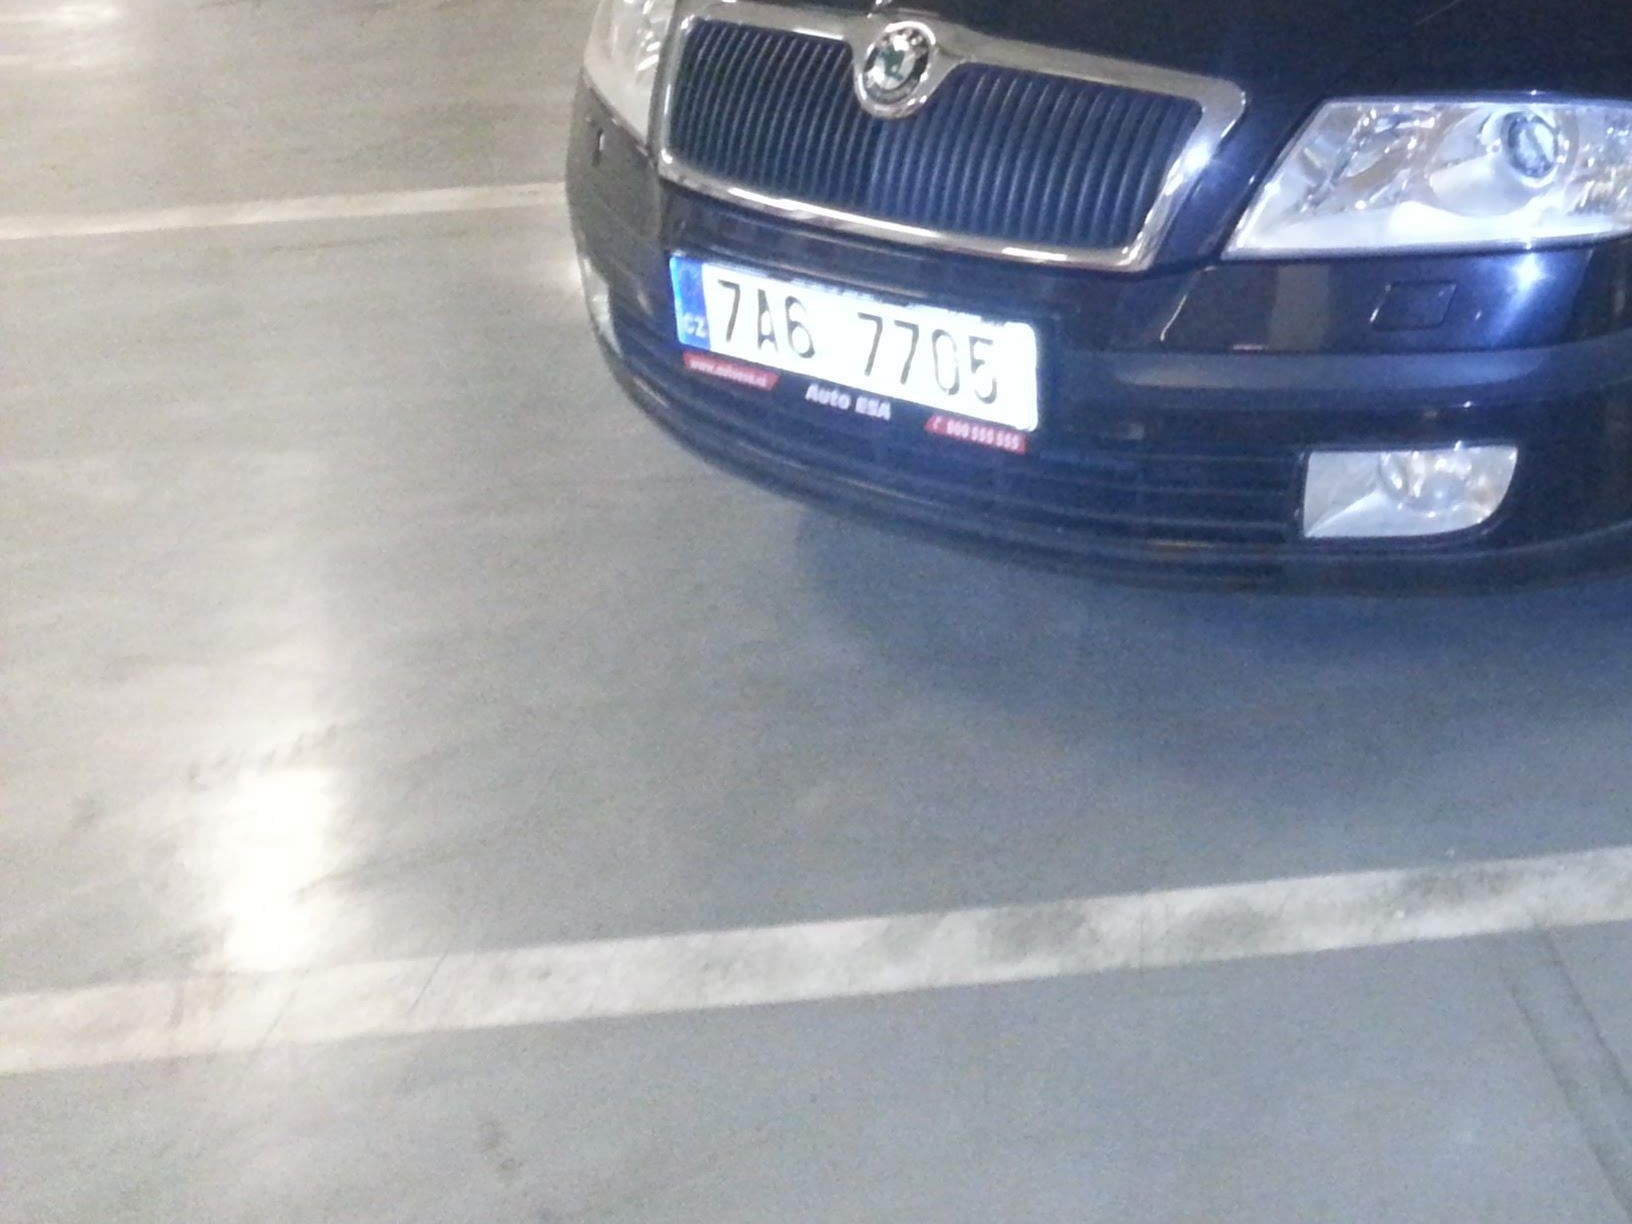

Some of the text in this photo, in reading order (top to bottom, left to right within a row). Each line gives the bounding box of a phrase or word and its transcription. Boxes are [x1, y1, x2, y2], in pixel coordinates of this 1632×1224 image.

[682, 312, 706, 338] CZ
[717, 279, 998, 405] 7A6 7705
[804, 382, 851, 410] Auto
